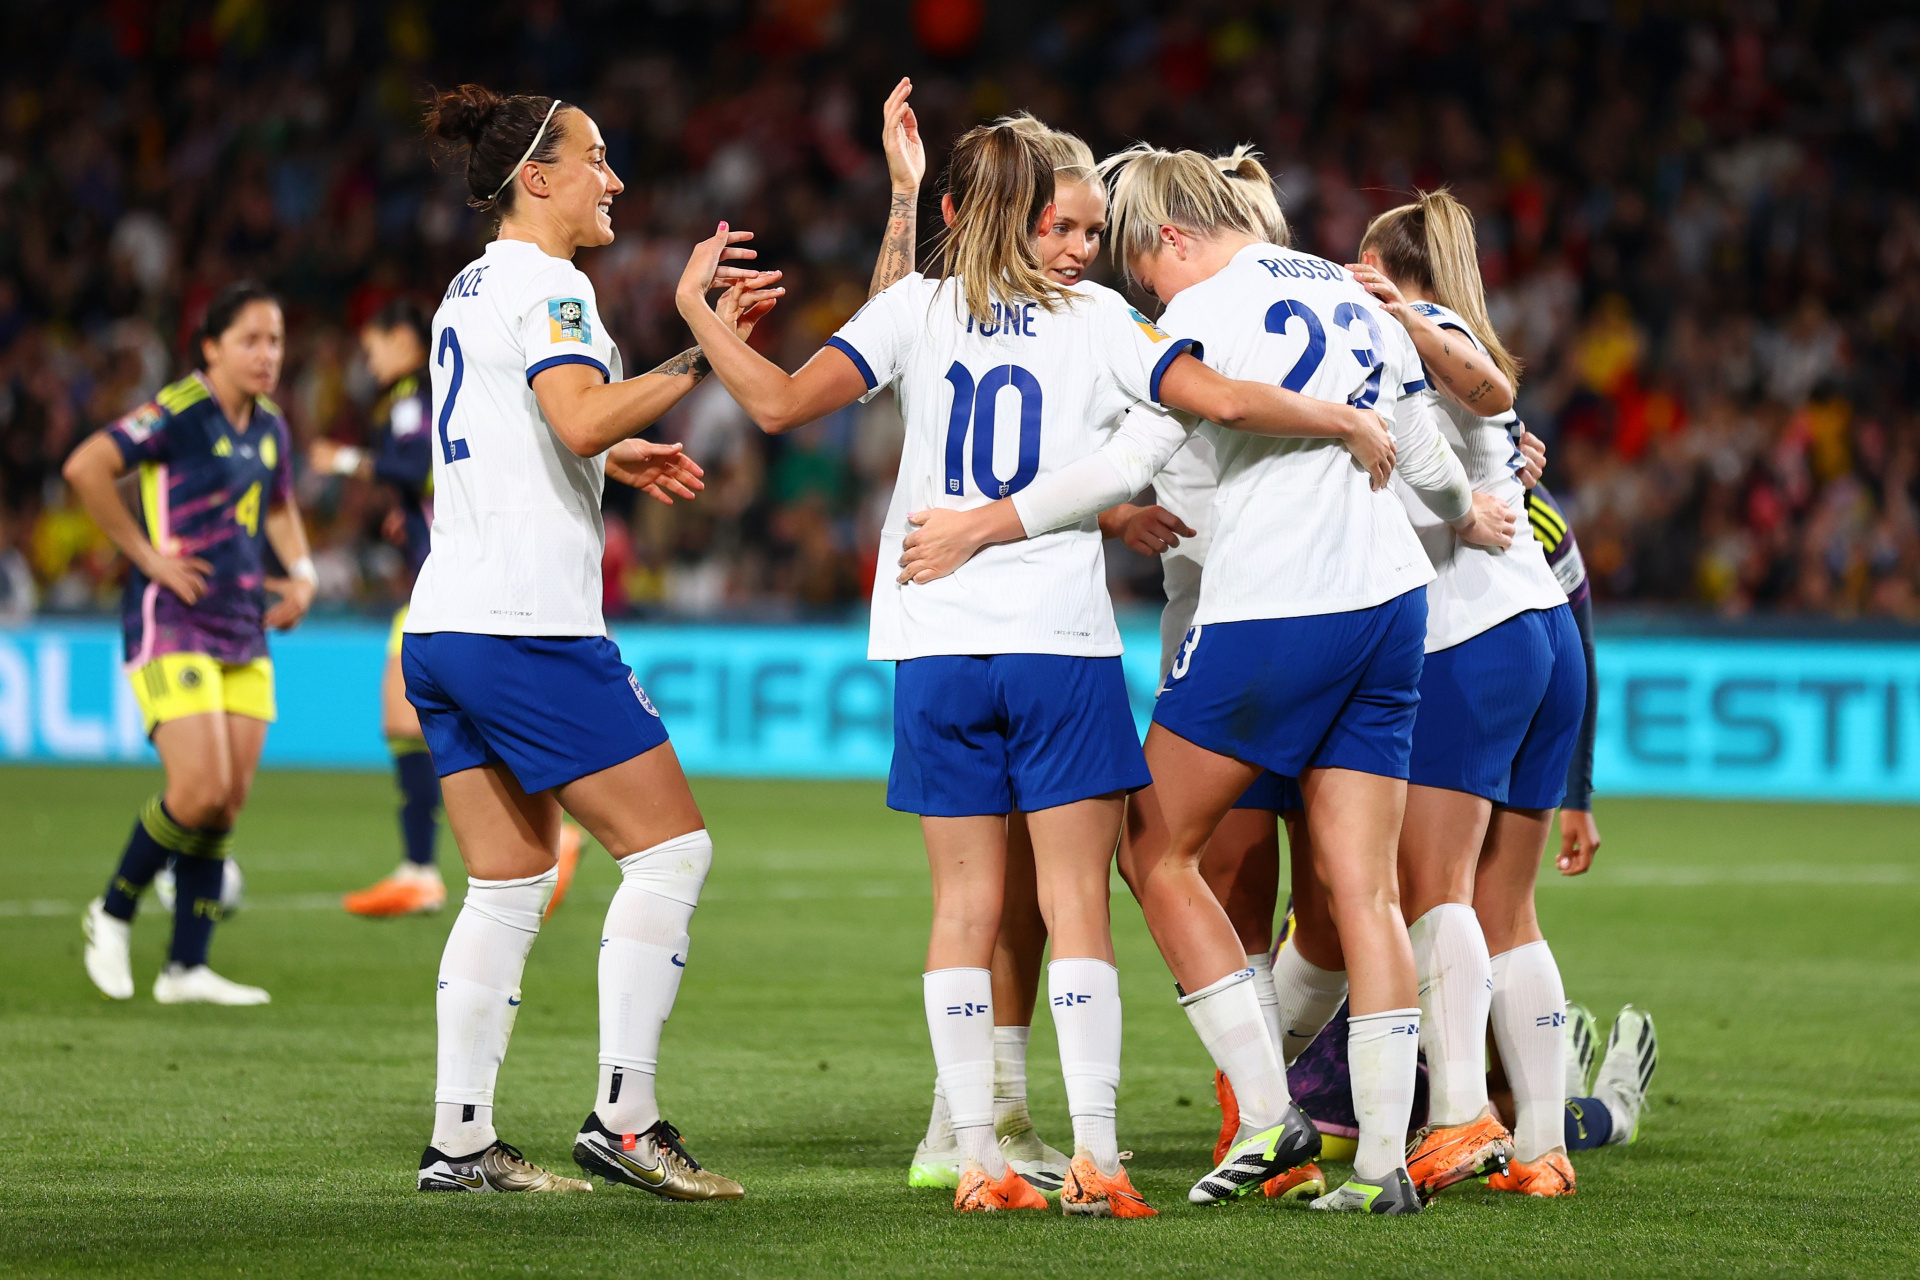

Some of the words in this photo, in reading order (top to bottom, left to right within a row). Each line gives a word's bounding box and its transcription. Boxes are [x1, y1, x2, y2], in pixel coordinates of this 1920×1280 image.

[1257, 258, 1344, 281] RUSSO
[437, 326, 471, 465] 2
[1264, 299, 1384, 410] 23
[944, 360, 1043, 500] 10
[235, 480, 263, 538] 4
[644, 660, 896, 744] FIFA
[1598, 676, 1920, 771] ESTI
